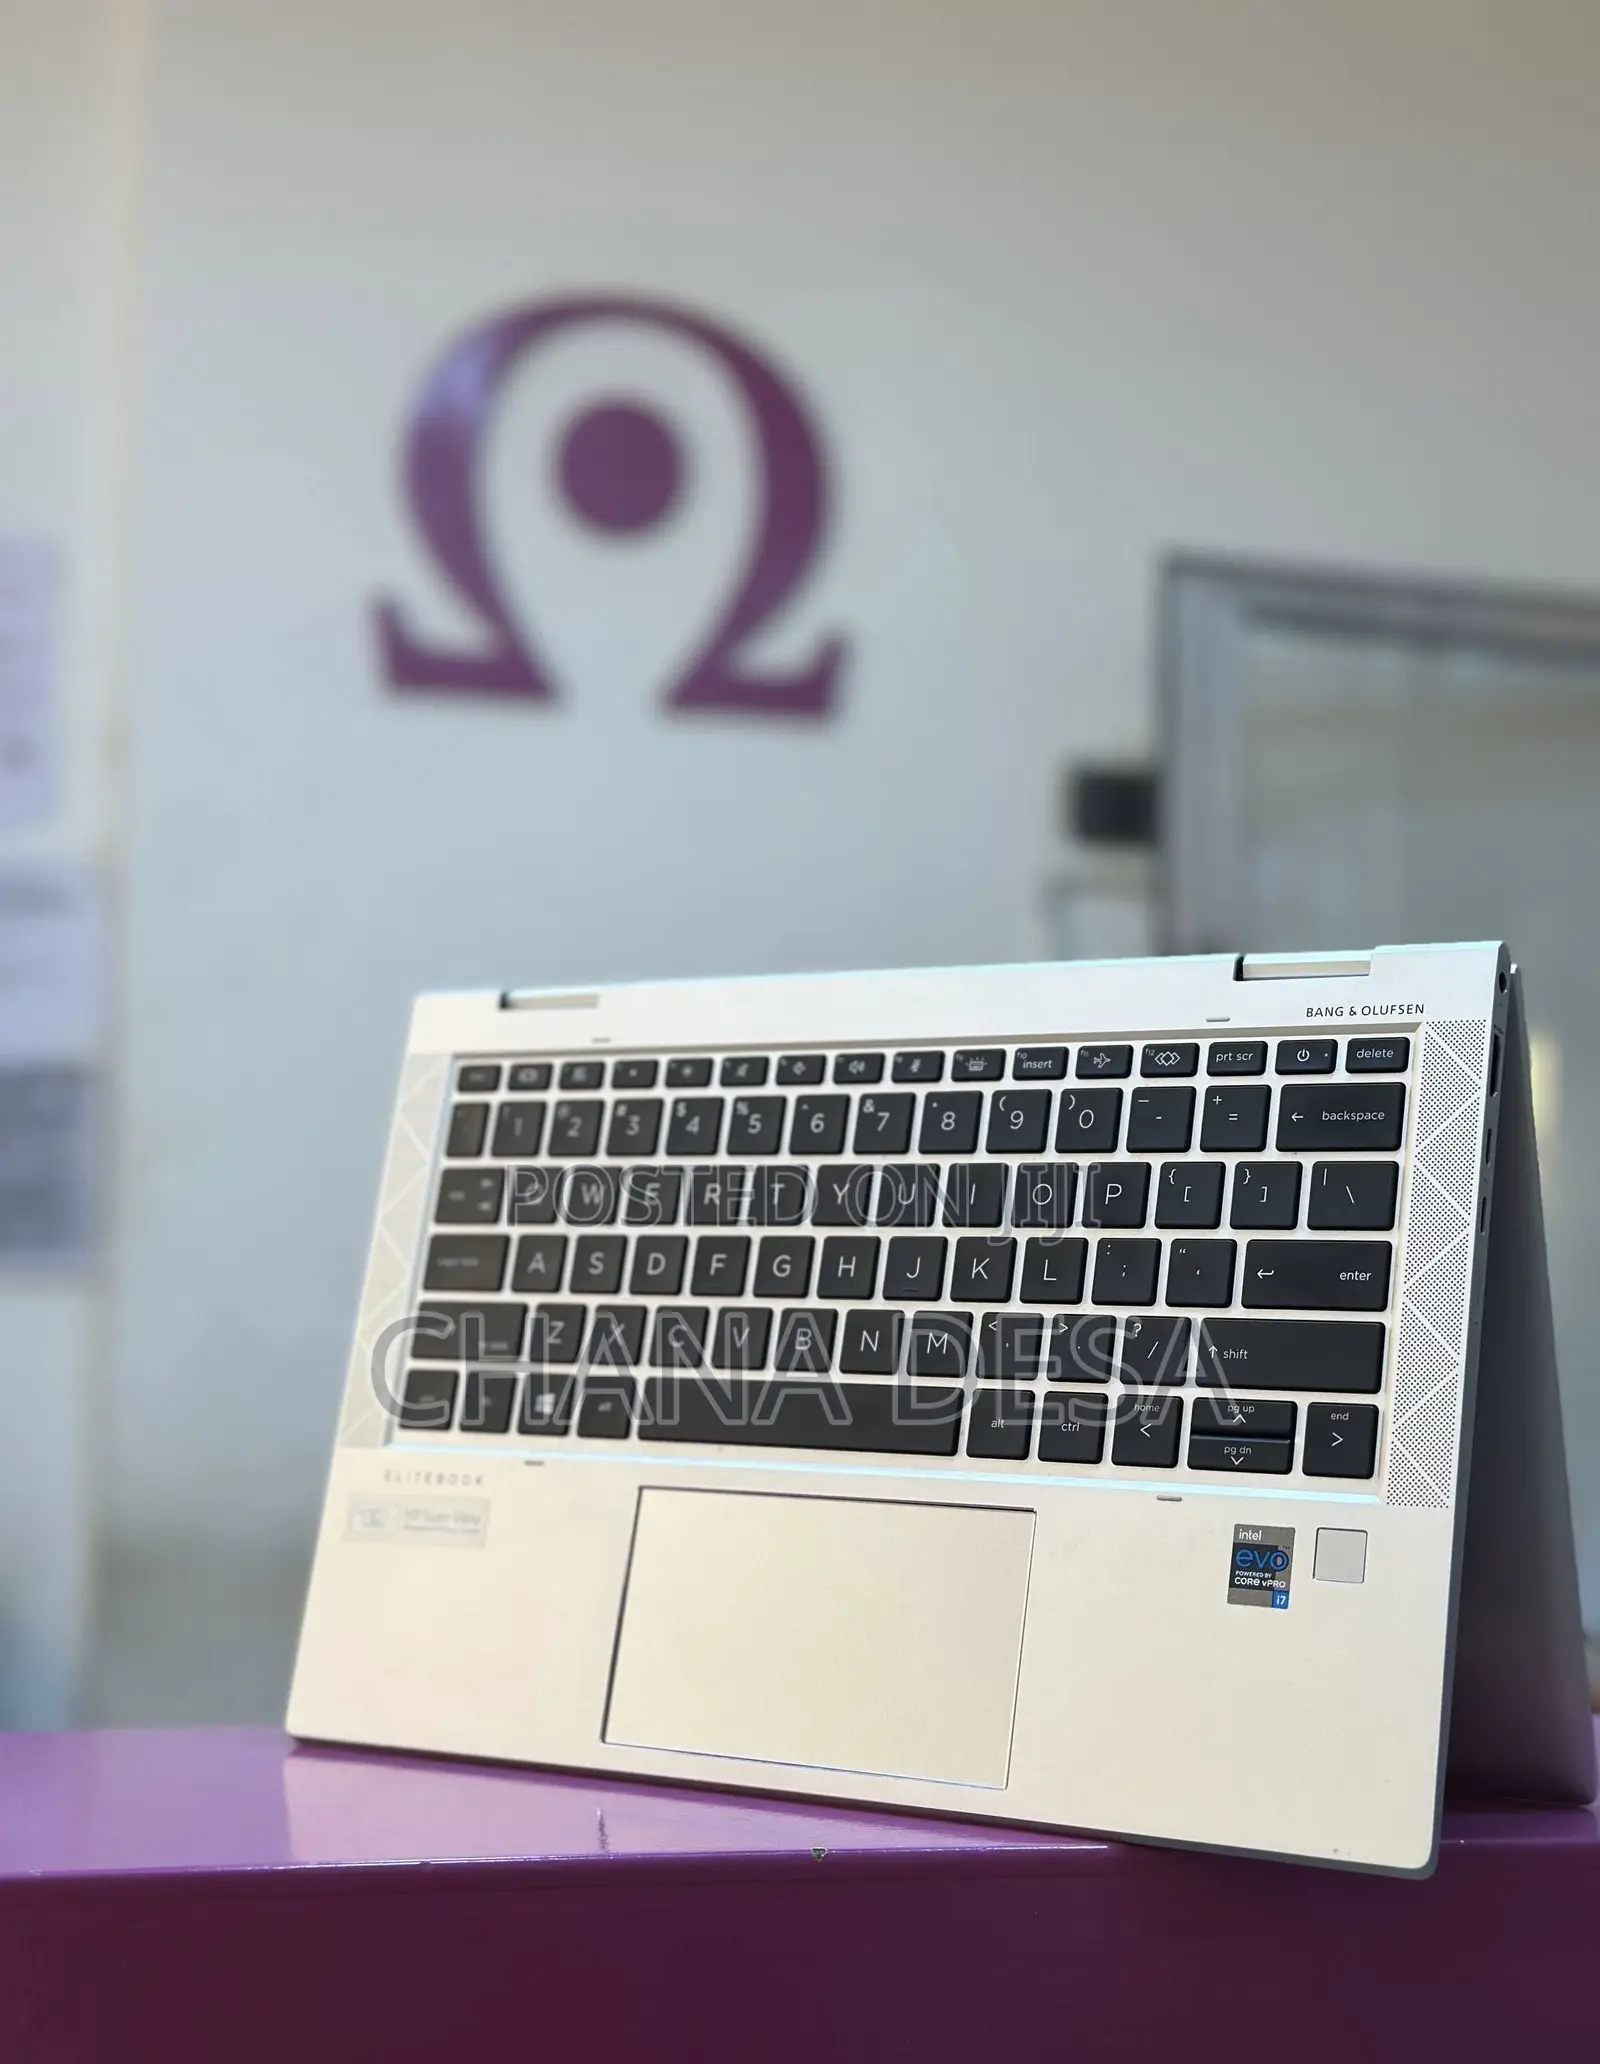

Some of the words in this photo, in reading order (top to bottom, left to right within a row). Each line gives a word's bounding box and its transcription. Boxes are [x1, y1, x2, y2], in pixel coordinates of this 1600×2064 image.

[1306, 1007, 1344, 1017] BANG
[1348, 1006, 1357, 1016] &
[1361, 1004, 1425, 1016] OLUFSEN
[1216, 1053, 1232, 1062] prt
[1357, 1049, 1393, 1058] delete
[1022, 1059, 1053, 1070] insert
[626, 1114, 640, 1136] 3
[686, 1115, 700, 1134] 4
[746, 1113, 762, 1134] 5
[811, 1113, 824, 1133] 6
[876, 1112, 890, 1131] 7
[941, 1112, 955, 1130] 8
[1010, 1111, 1023, 1129] 9
[1322, 1111, 1384, 1121] backspace
[567, 1116, 582, 1137] 2
[580, 1182, 606, 1206] W
[704, 1182, 722, 1206] R
[770, 1182, 787, 1206] T
[831, 1182, 850, 1206] Y
[898, 1183, 916, 1205] U
[1032, 1183, 1053, 1205] O
[1106, 1184, 1122, 1204] P
[527, 1251, 546, 1275] A
[588, 1251, 605, 1275] S
[647, 1253, 665, 1275] D
[710, 1254, 726, 1275] F
[773, 1255, 790, 1277] G
[839, 1256, 855, 1277] H
[907, 1258, 920, 1278] J
[972, 1258, 989, 1279] K
[1044, 1260, 1056, 1280] L
[1340, 1271, 1371, 1280] enter
[545, 1321, 565, 1345] Z
[732, 1326, 750, 1349] V
[795, 1328, 812, 1350] B
[861, 1331, 879, 1351] N
[926, 1332, 948, 1354] M
[1224, 1349, 1247, 1359] shift
[1134, 1402, 1160, 1412] home
[1227, 1404, 1240, 1414] pg
[1242, 1404, 1256, 1415] up
[991, 1417, 1005, 1429] alt
[1062, 1419, 1080, 1431] ctrl
[1224, 1447, 1236, 1457] pg
[1240, 1446, 1251, 1454] dn
[1238, 1529, 1262, 1541] intel
[1235, 1549, 1288, 1571] evo
[1261, 1580, 1286, 1588] vPRO
[1276, 1595, 1286, 1605] i7
